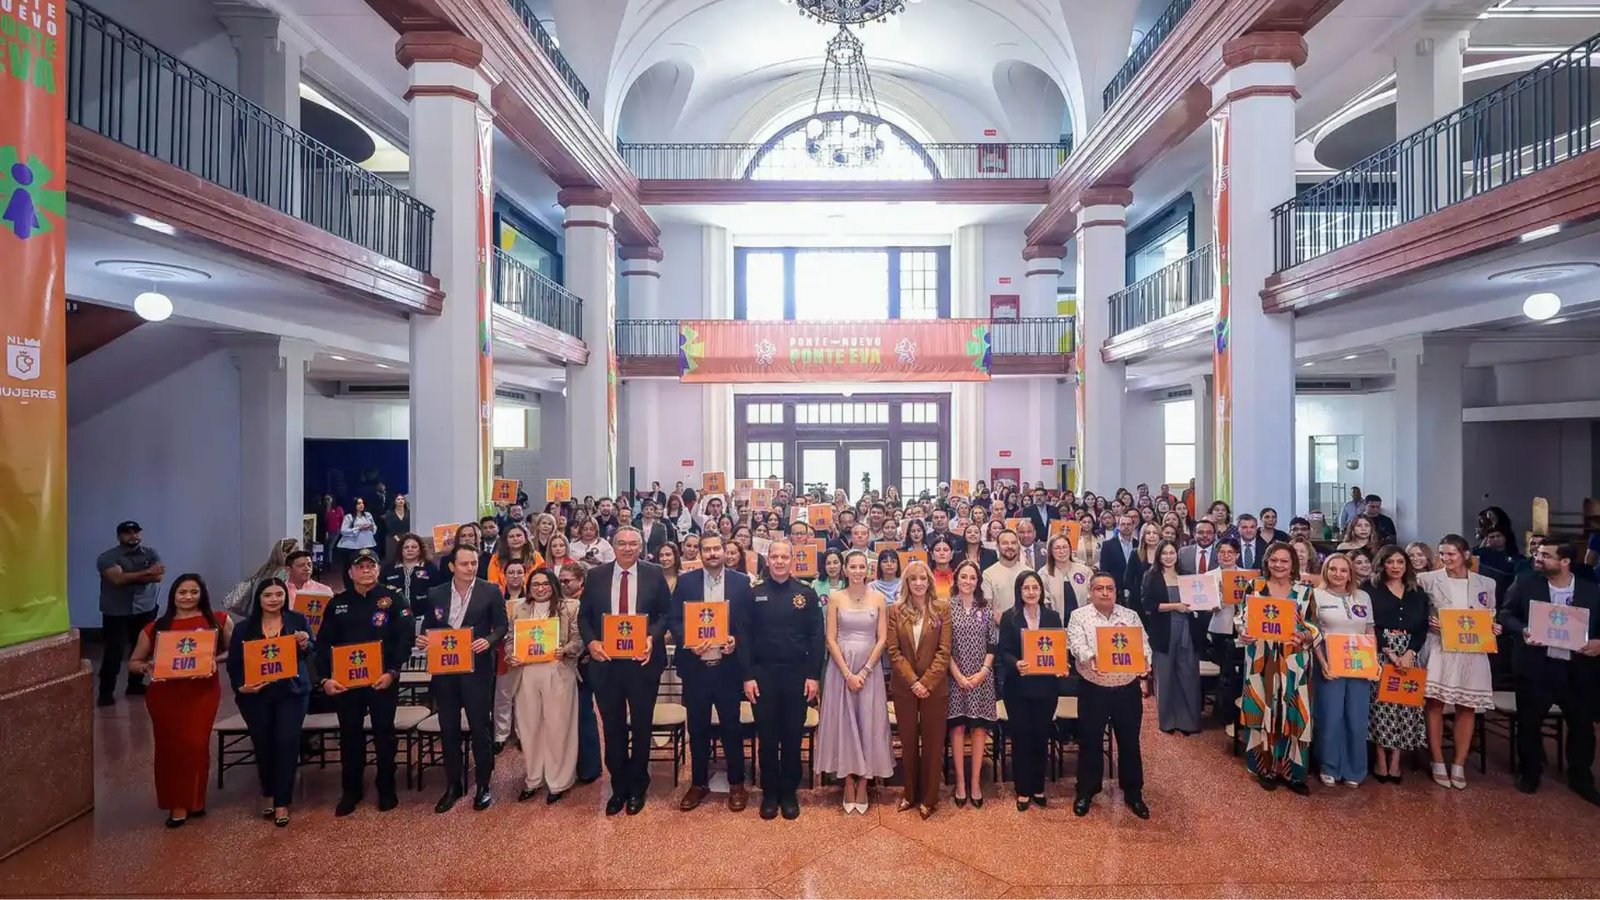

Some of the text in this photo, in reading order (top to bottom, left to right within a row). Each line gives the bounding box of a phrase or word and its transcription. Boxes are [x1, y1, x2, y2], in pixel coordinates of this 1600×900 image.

[841, 337, 882, 347] NUEVO
[789, 348, 882, 364] PONTE EVA
[698, 626, 716, 639] EVA
[1262, 621, 1281, 634] EVA
[1547, 627, 1570, 640] EVA
[616, 639, 634, 650] EVA
[1458, 632, 1480, 645] EVA
[528, 643, 545, 656] EVA
[172, 656, 196, 670] EVA
[441, 653, 460, 666] EVA
[1036, 655, 1055, 667] EVA
[1111, 652, 1132, 665] EVA
[1343, 657, 1364, 670] EVA
[260, 661, 283, 676] EVA
[348, 667, 369, 680] EVA
